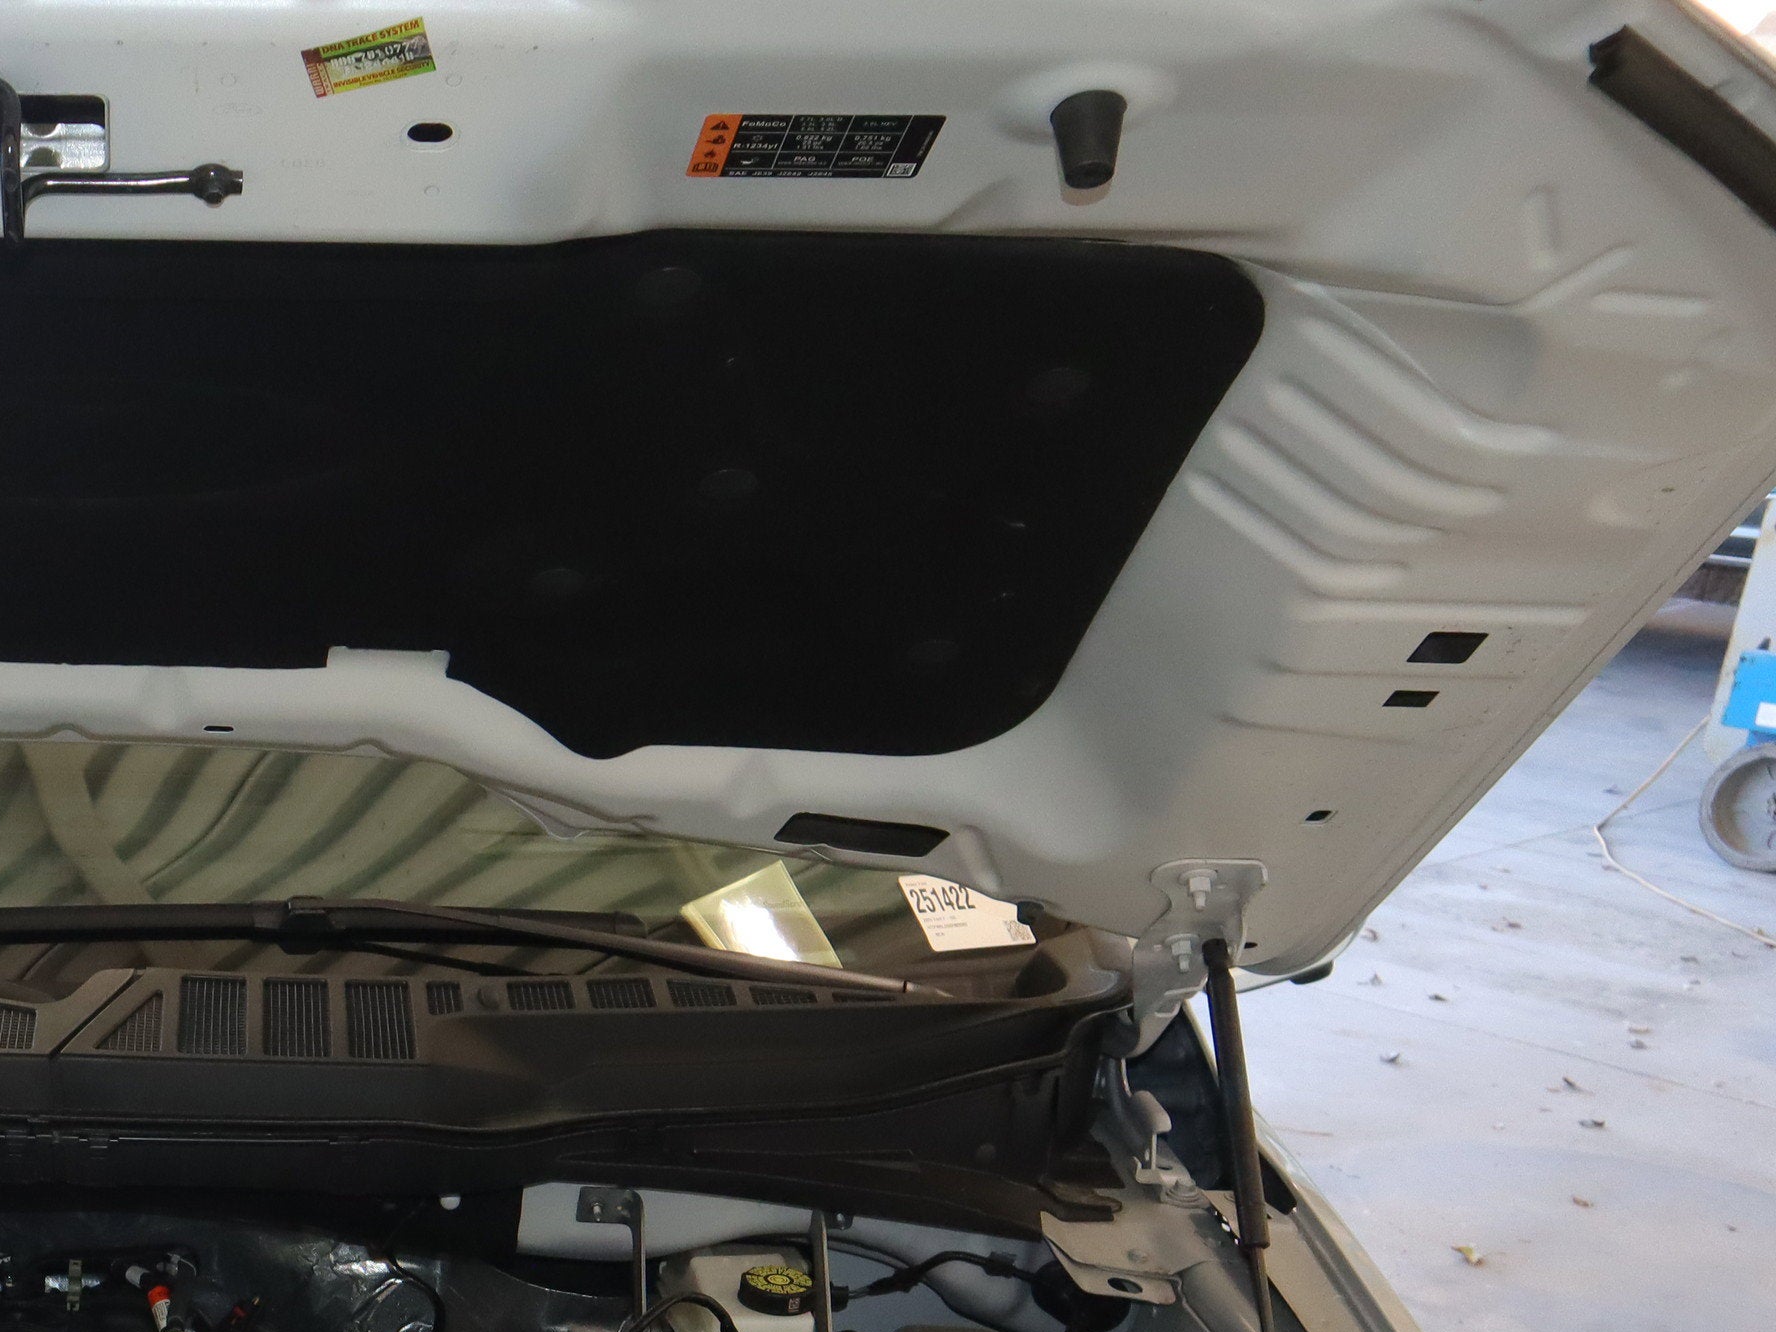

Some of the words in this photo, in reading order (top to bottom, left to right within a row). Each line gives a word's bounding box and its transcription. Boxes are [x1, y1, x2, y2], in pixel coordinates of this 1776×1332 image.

[322, 43, 344, 54] DNA
[346, 32, 378, 47] TRACE
[379, 19, 420, 39] SYSTEM
[909, 885, 976, 914] 251422
